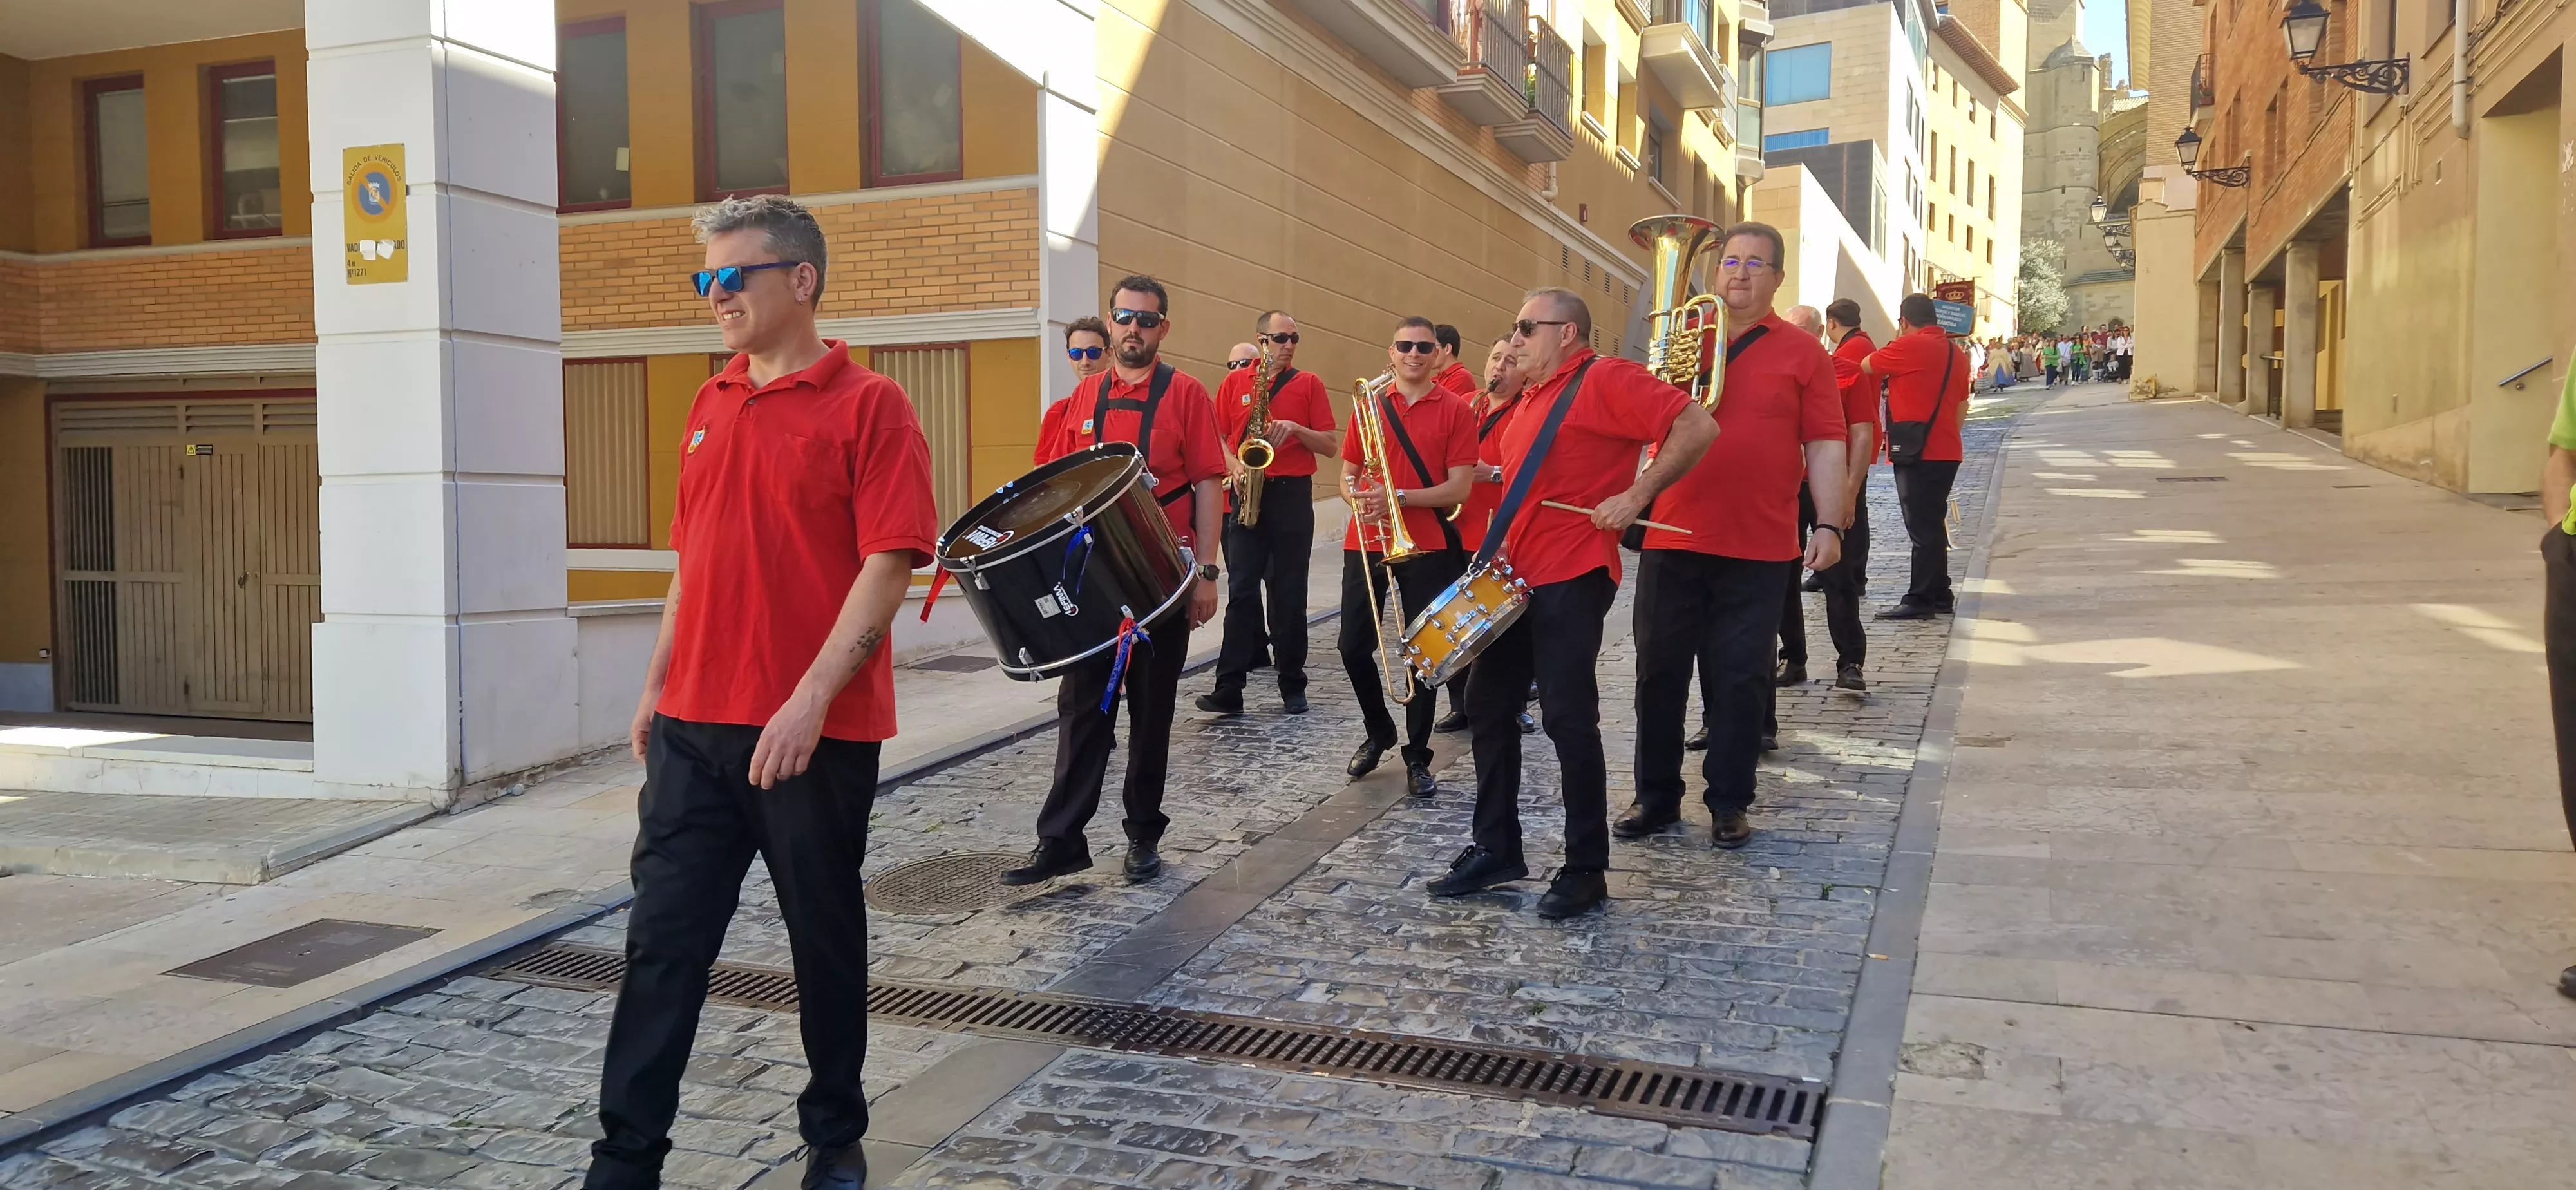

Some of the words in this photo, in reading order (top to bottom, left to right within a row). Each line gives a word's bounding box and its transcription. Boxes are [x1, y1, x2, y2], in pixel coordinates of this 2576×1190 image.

[346, 162, 362, 185] SALIDA
[363, 155, 372, 163] DE
[374, 154, 402, 182] VEHICULOS
